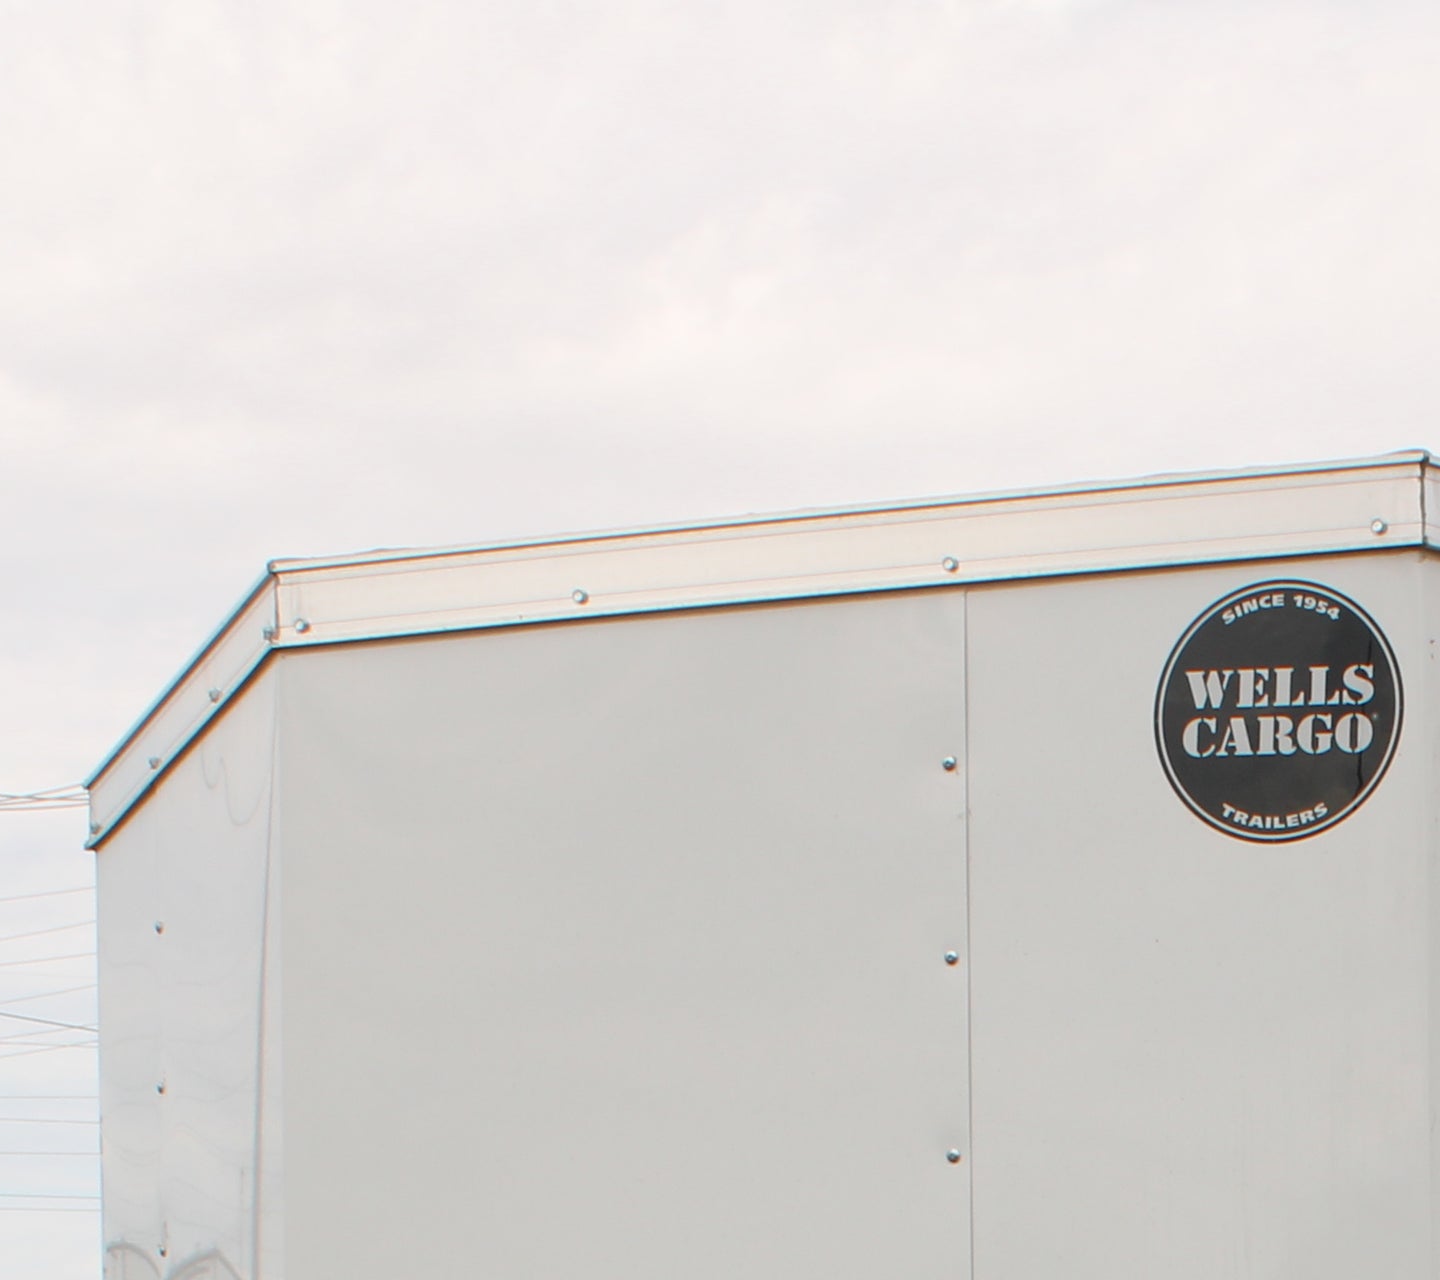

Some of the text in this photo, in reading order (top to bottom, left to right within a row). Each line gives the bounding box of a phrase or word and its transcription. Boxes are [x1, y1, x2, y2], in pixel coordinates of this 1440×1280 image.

[1222, 593, 1341, 625] SINCE 1954
[1184, 664, 1375, 709] WELLS
[1182, 713, 1374, 758] CARGO
[1221, 802, 1328, 829] TRAILERS
